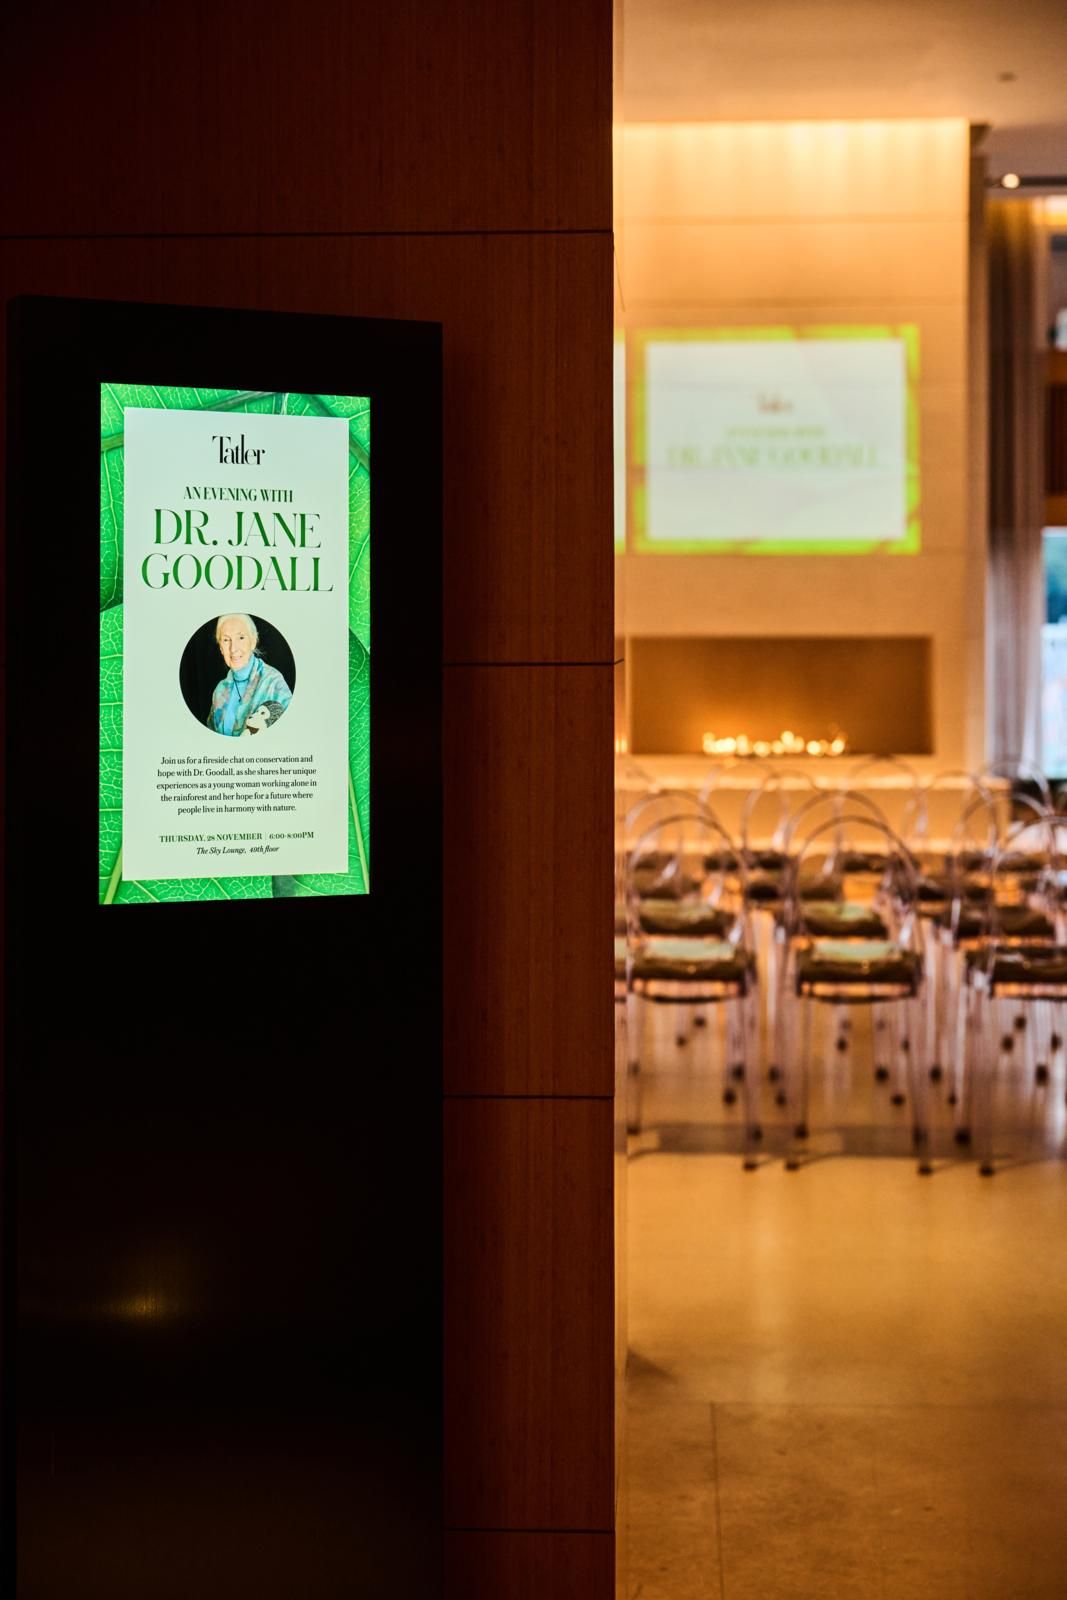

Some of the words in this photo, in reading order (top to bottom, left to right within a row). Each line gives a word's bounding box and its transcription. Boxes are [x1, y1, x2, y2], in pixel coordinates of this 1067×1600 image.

[212, 434, 265, 465] Tatler
[184, 486, 200, 500] AN
[204, 487, 257, 502] EVENING
[260, 489, 293, 503] WITH
[154, 509, 218, 546] DR.
[227, 511, 321, 549] JANE
[141, 553, 333, 592] GOODALL
[160, 756, 176, 765] Join
[186, 756, 197, 764] for
[202, 756, 229, 764] fireside
[229, 756, 245, 764] chat
[255, 755, 300, 763] conservation
[300, 755, 313, 763] and
[157, 769, 176, 779] hope
[176, 769, 192, 777] with
[193, 768, 204, 777] Dr.
[205, 768, 235, 777] Goodall,
[244, 768, 257, 776] she
[257, 767, 279, 775] shares
[279, 767, 292, 775] her
[292, 767, 317, 776] unique
[156, 781, 199, 791] experiences
[212, 782, 235, 790] young
[261, 780, 291, 788] working
[290, 779, 309, 787] alone
[310, 779, 317, 787] in
[160, 794, 172, 802] the
[173, 793, 208, 802] rainforest
[208, 793, 222, 801] and
[235, 792, 255, 801] hope
[292, 791, 314, 799] where
[177, 805, 202, 816] people
[202, 805, 216, 813] live
[224, 804, 256, 814] harmony
[256, 804, 272, 812] with
[159, 834, 206, 843] THURSDAY,
[215, 832, 263, 841] NOVEMBER
[196, 847, 208, 855] The
[209, 847, 222, 855] Sky
[222, 846, 247, 854] Lounge,
[263, 845, 280, 854] floor
